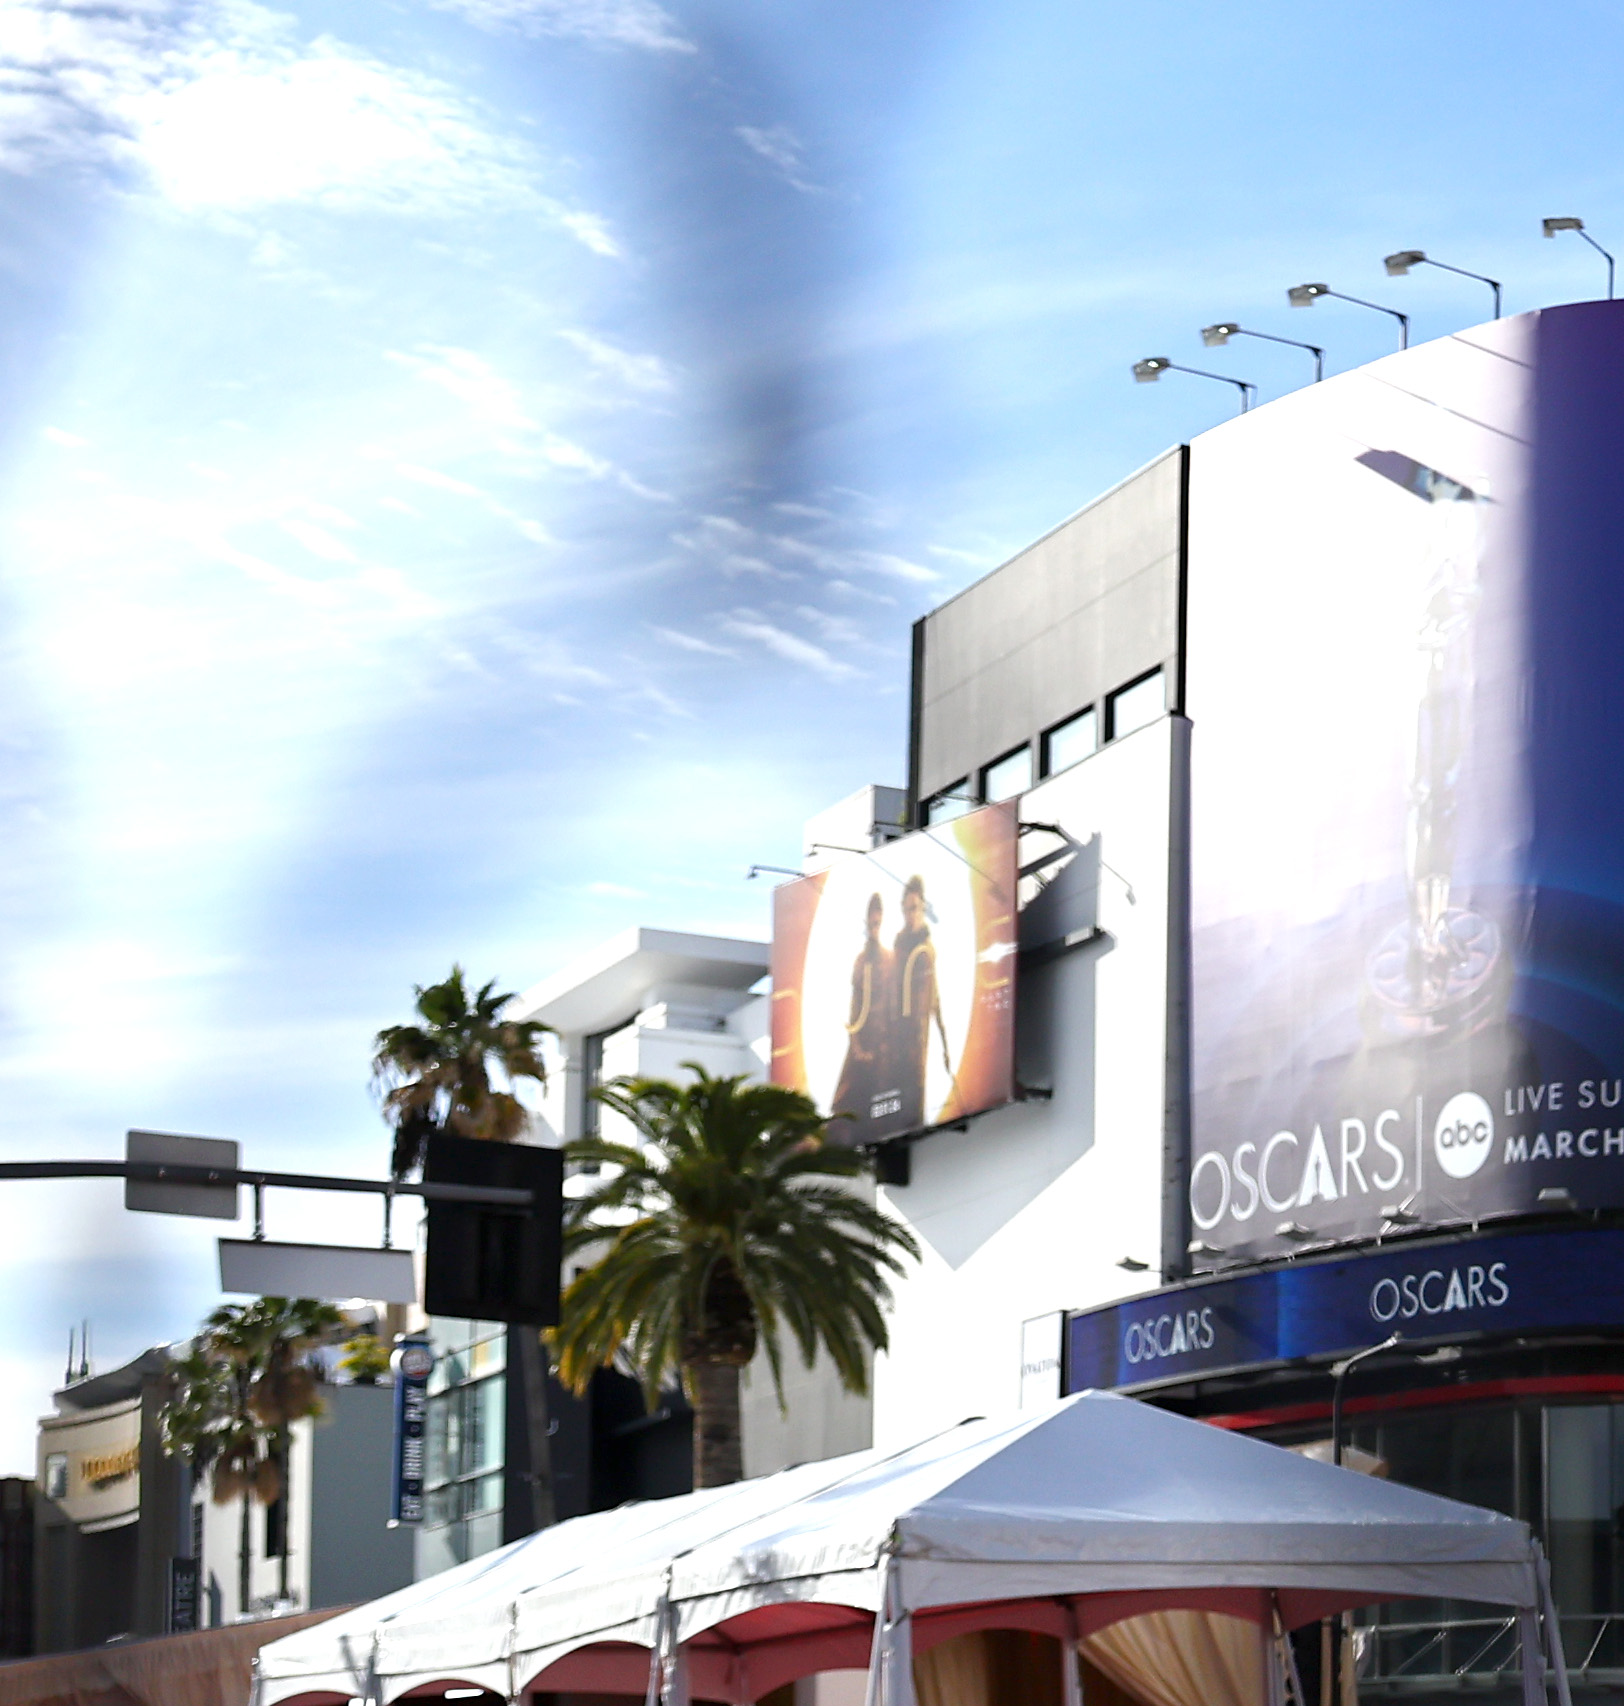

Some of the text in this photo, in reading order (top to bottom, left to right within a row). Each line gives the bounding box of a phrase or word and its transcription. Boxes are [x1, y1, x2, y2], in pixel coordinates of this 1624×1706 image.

[1503, 1082, 1565, 1117] LIVE
[1440, 1118, 1490, 1150] abc
[1190, 1108, 1405, 1230] OSCARS
[1370, 1261, 1511, 1323] OSCARS
[1123, 1305, 1216, 1365] OSCARS
